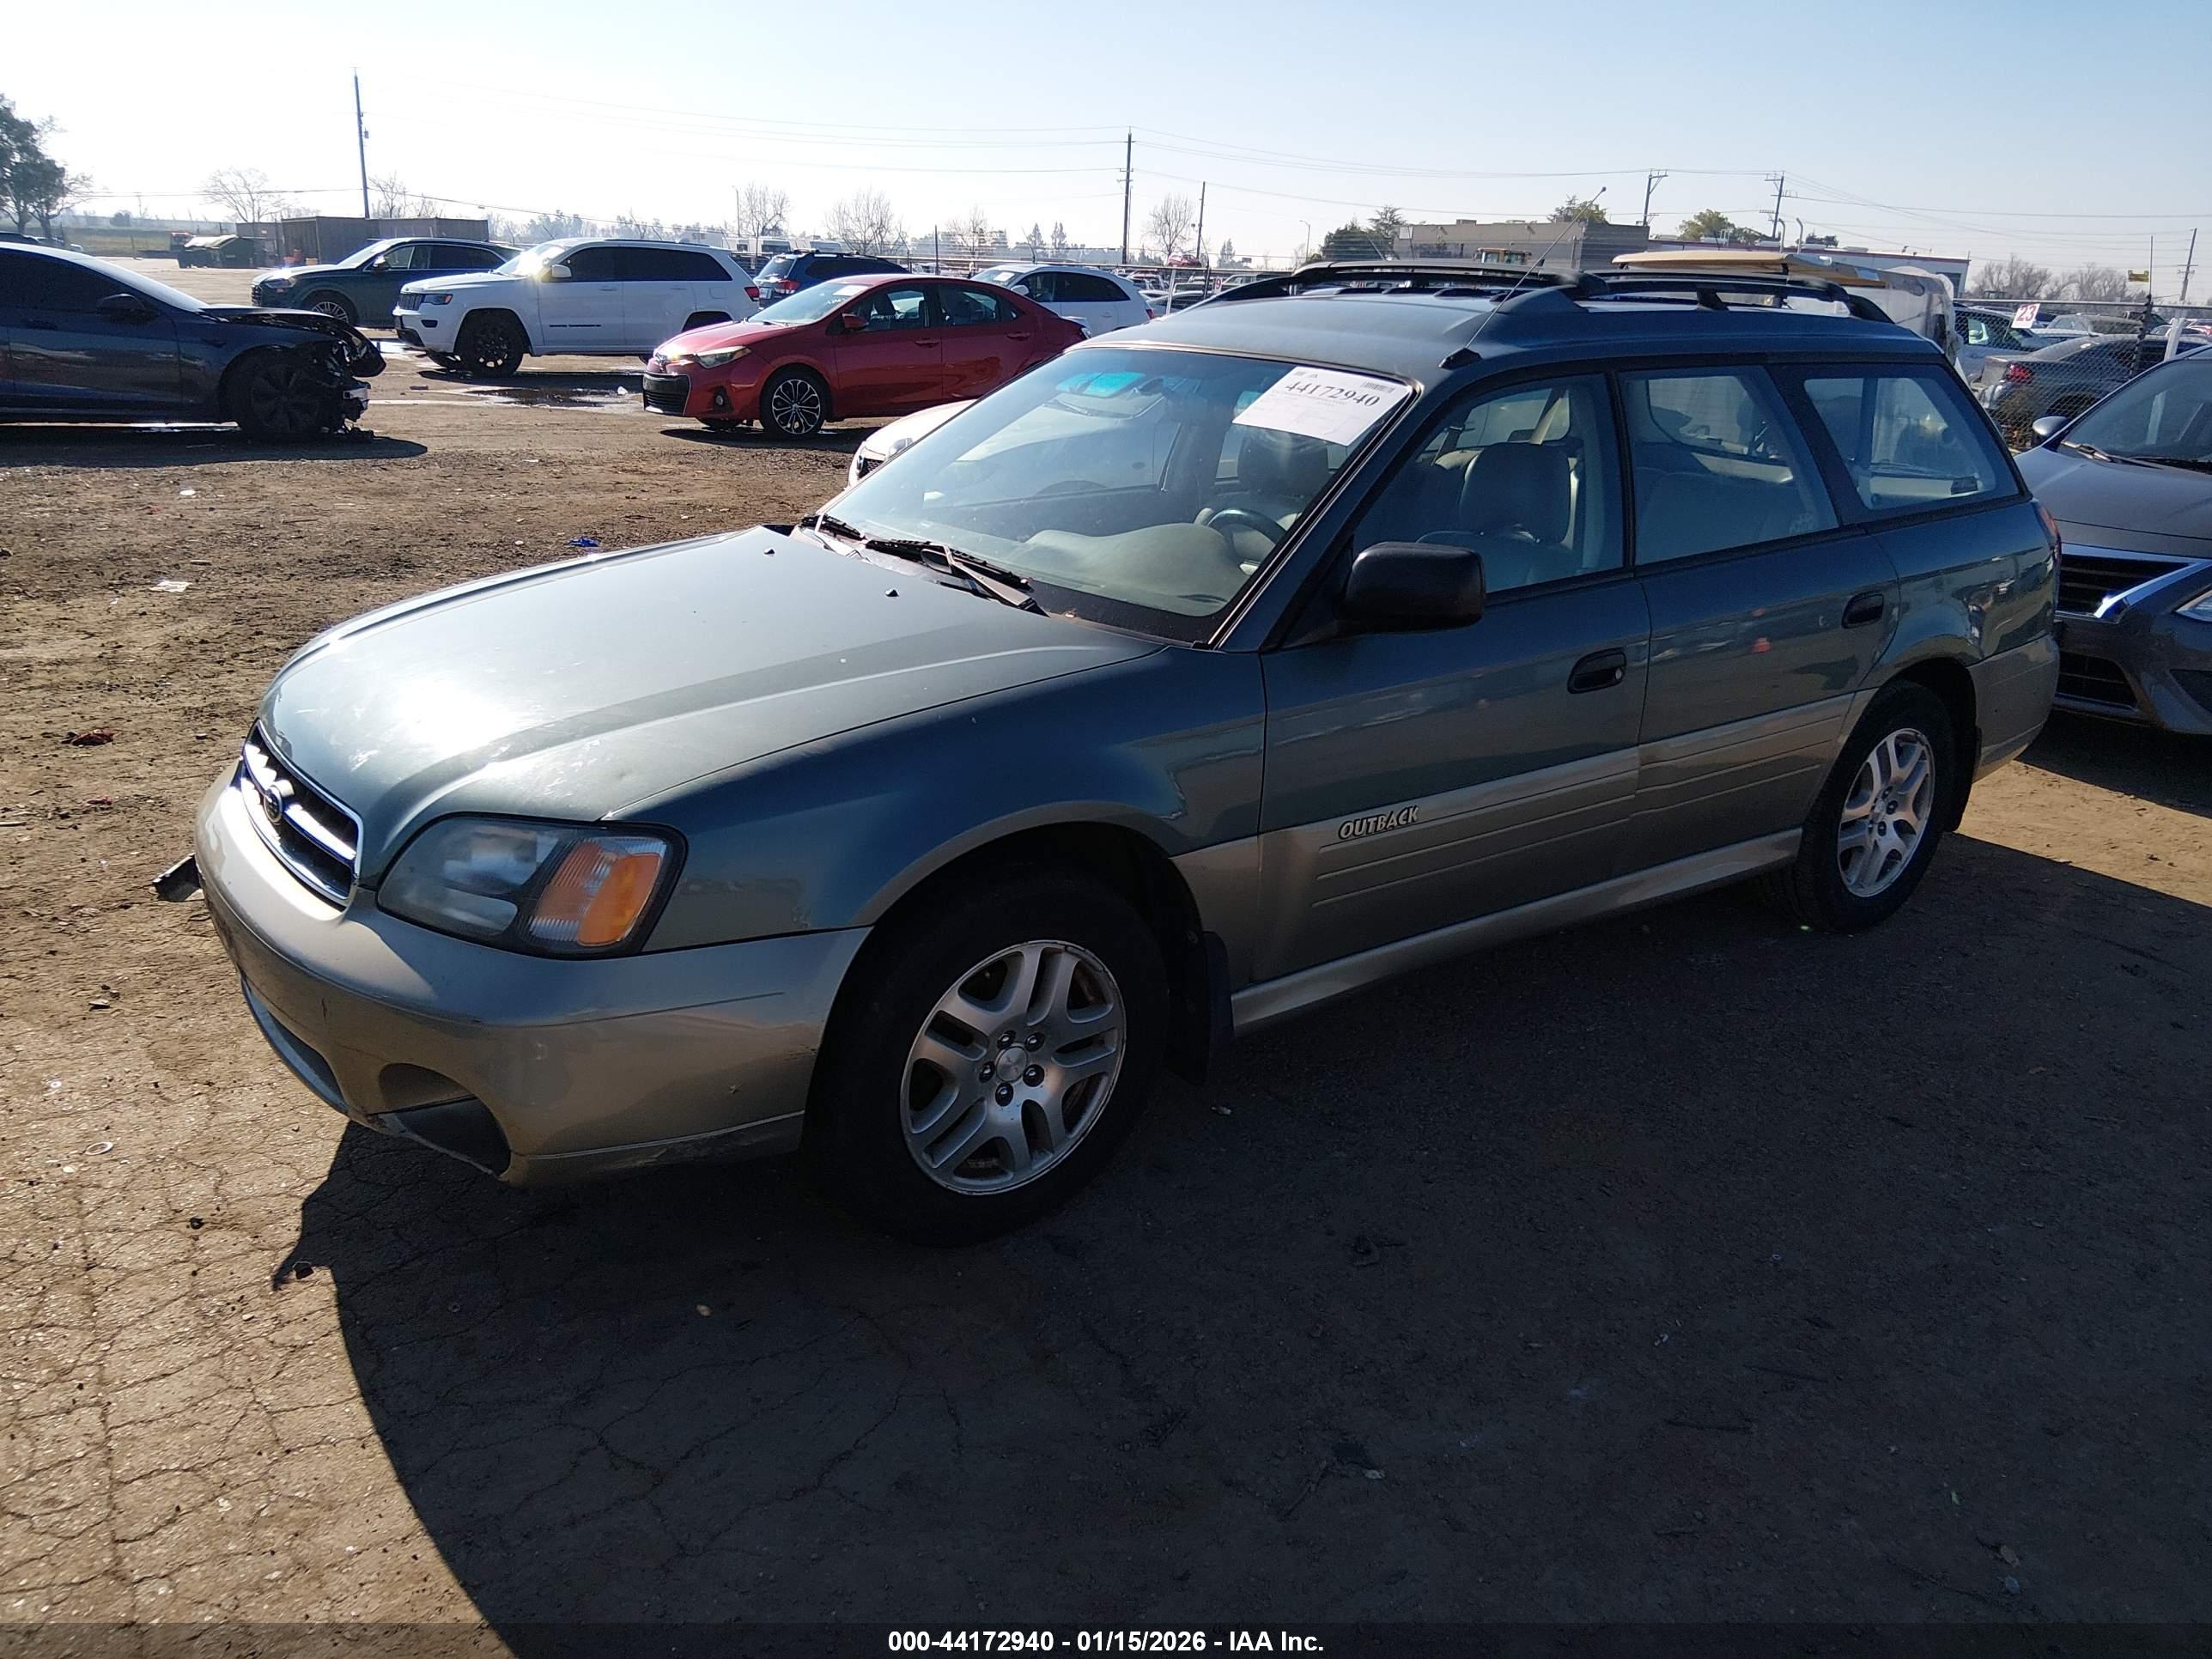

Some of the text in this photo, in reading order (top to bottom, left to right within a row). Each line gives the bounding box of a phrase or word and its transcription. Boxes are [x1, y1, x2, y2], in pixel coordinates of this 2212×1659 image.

[2016, 305, 2037, 321] 23
[1285, 381, 1381, 406] 44172940
[1338, 805, 1419, 839] OUTBACK
